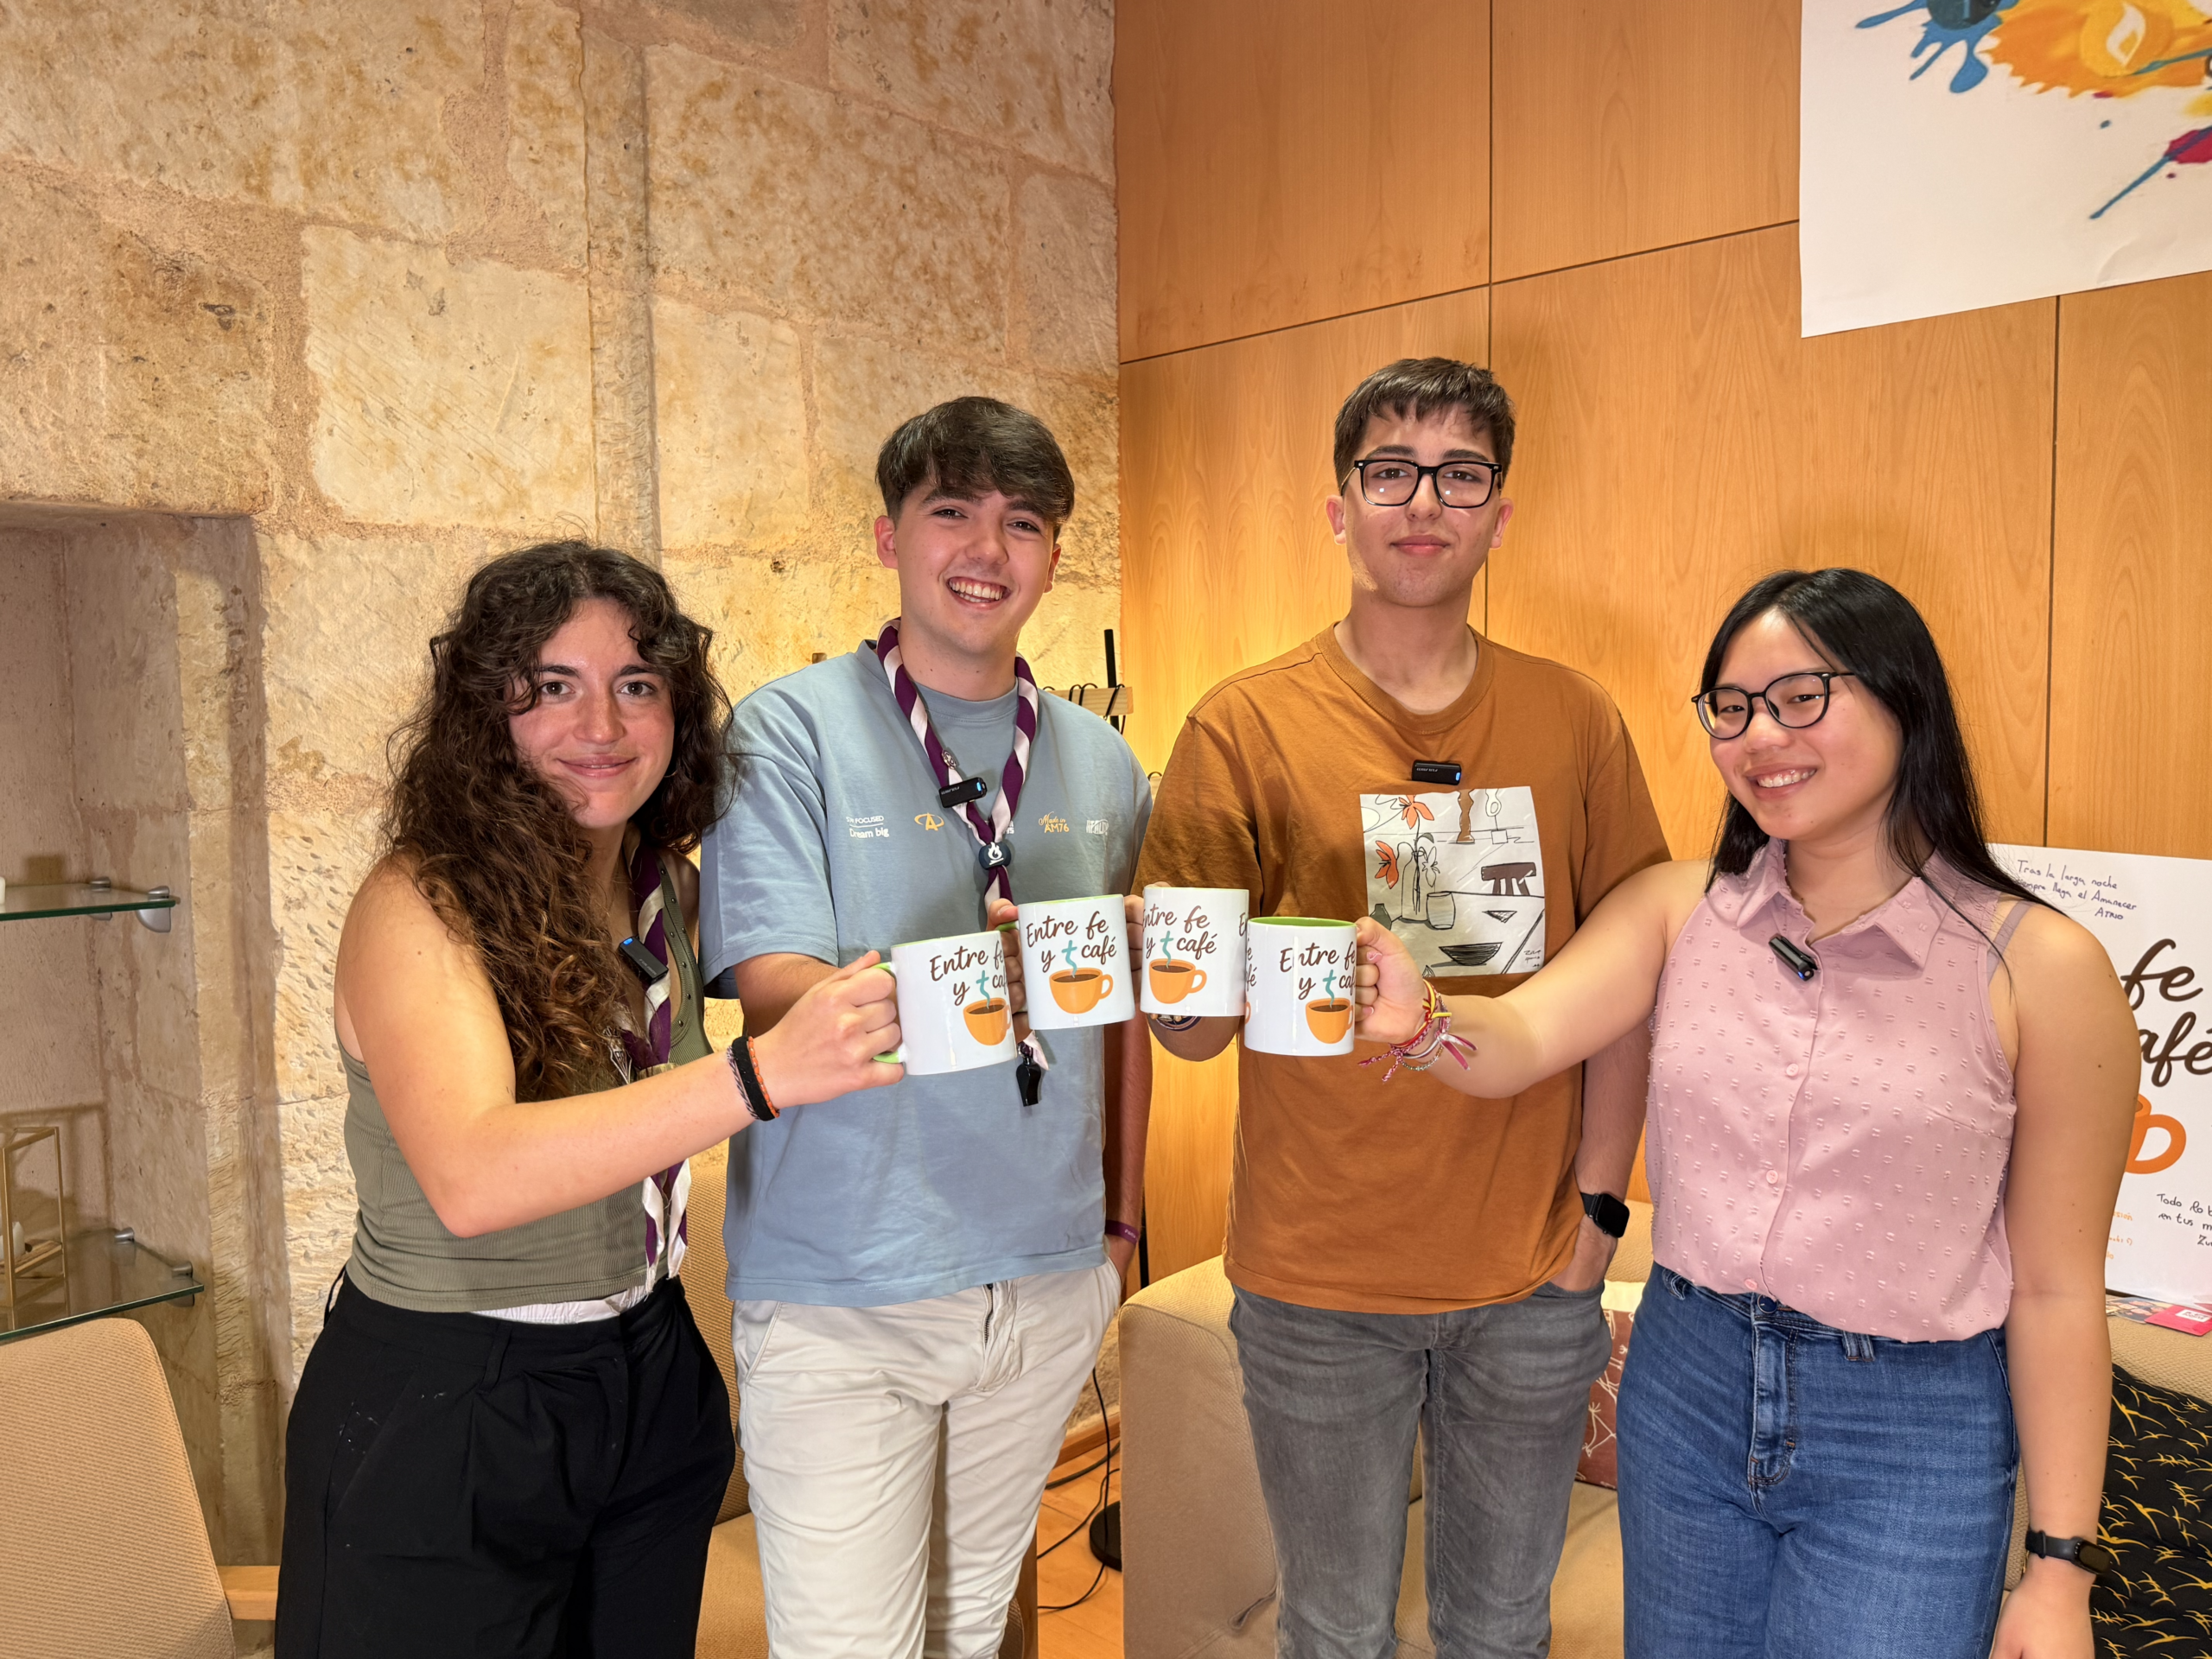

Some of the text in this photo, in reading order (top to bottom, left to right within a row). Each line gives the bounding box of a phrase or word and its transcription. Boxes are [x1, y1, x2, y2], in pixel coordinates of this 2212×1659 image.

[849, 827, 890, 839] Dream big
[2017, 859, 2118, 890] Tras la larga noche
[2015, 878, 2138, 911] iempre llega el Amanecer
[1027, 910, 1109, 949] Entre fe
[1184, 905, 1211, 934] fe
[1040, 935, 1117, 973] y café
[1145, 931, 1218, 961] y café
[1280, 940, 1356, 973] Entre fe
[929, 945, 989, 982] Entre
[2120, 938, 2204, 1012] fe
[952, 965, 1007, 1007] y caf
[1298, 966, 1356, 1001] y caf
[2139, 1011, 2212, 1088] afé
[2156, 1192, 2183, 1208] Todo
[2189, 1200, 2204, 1214] lo
[2158, 1212, 2172, 1221] en
[2175, 1213, 2194, 1227] tus
